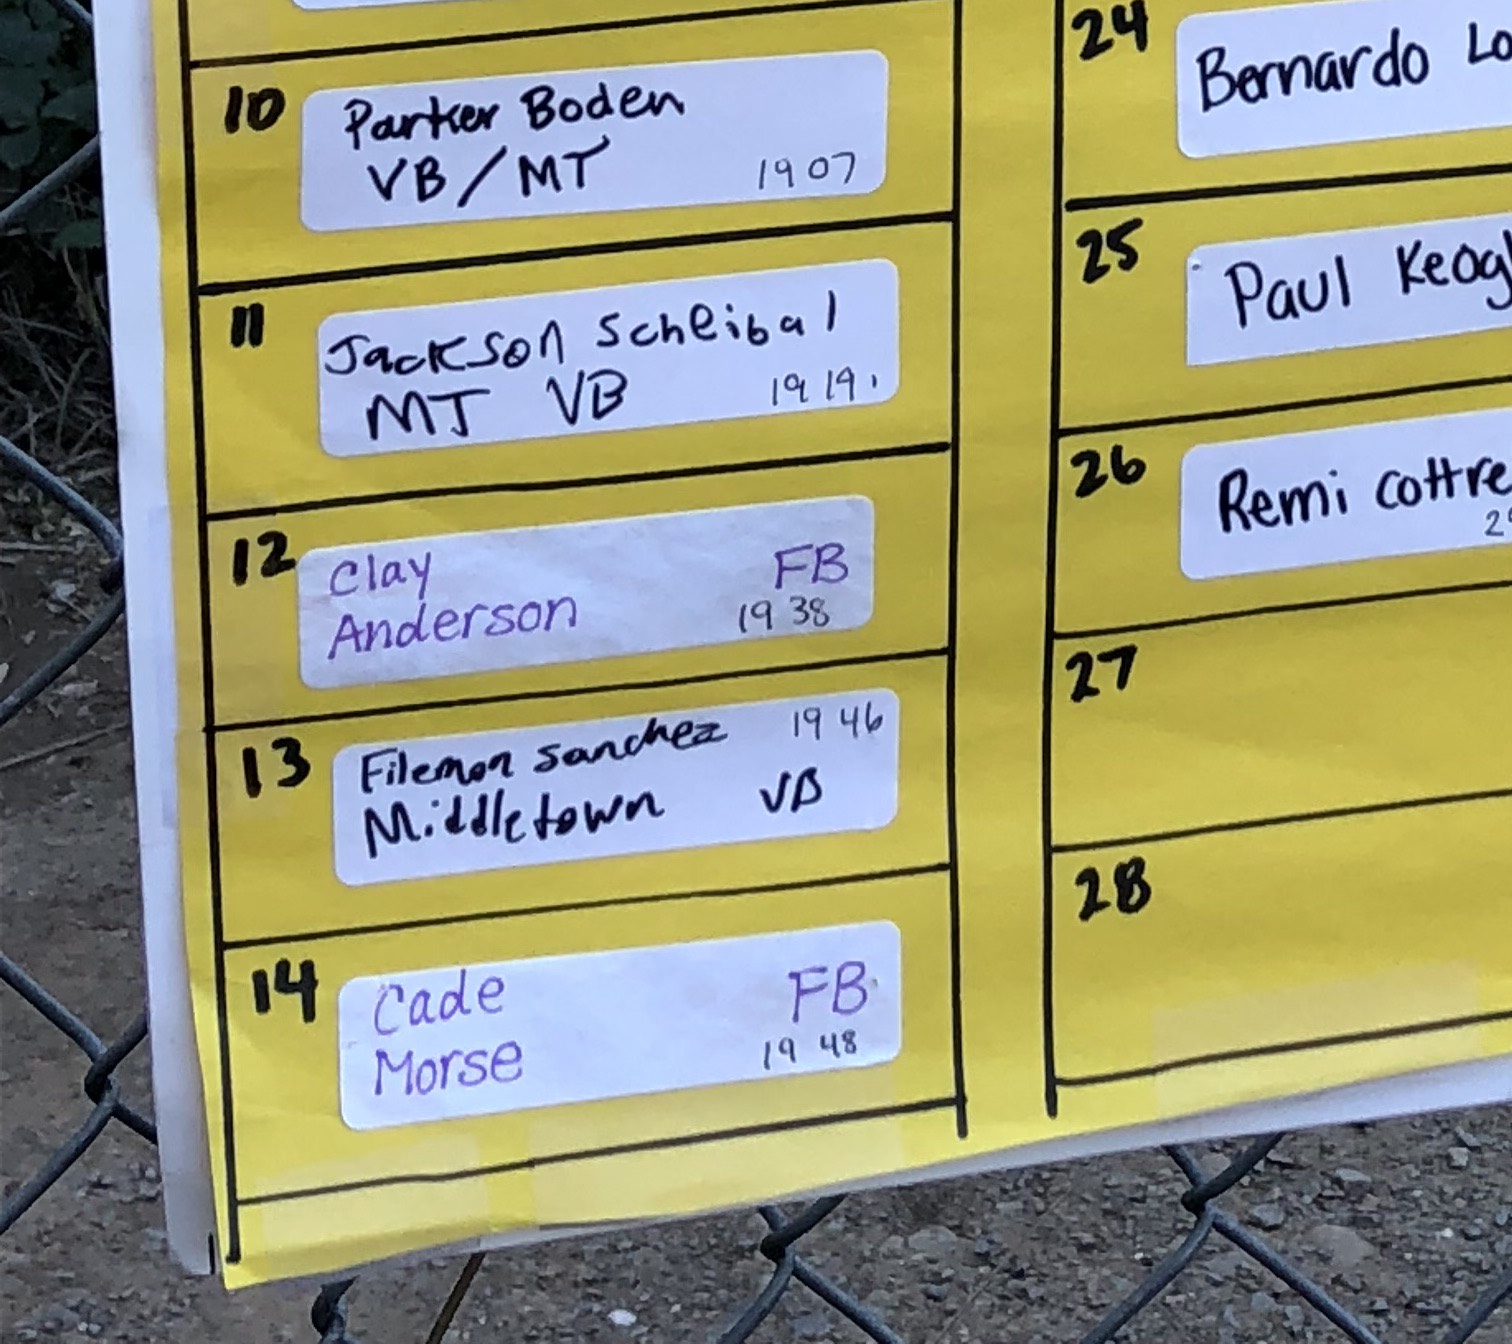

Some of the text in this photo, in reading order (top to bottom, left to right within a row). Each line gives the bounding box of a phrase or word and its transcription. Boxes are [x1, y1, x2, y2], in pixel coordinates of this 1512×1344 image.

[1195, 26, 1430, 113] Bernardo
[224, 85, 286, 135] 10
[519, 81, 685, 132] Boden
[1075, 217, 1144, 285] 25
[1223, 254, 1351, 330] Paul
[230, 302, 264, 349] 11
[546, 368, 628, 427] VB
[1070, 443, 1147, 499] 26
[1218, 467, 1348, 535] Remi
[232, 530, 299, 587] 12
[774, 542, 849, 590] FB
[327, 587, 577, 660] Anderson
[1064, 643, 1138, 704] 27
[242, 736, 311, 799] 13
[361, 766, 823, 859] Middletown VB
[1074, 855, 1152, 923] 28
[251, 957, 319, 1024] 14
[374, 968, 505, 1036] Cade
[788, 961, 868, 1024] FB
[374, 1040, 523, 1096] Morse
